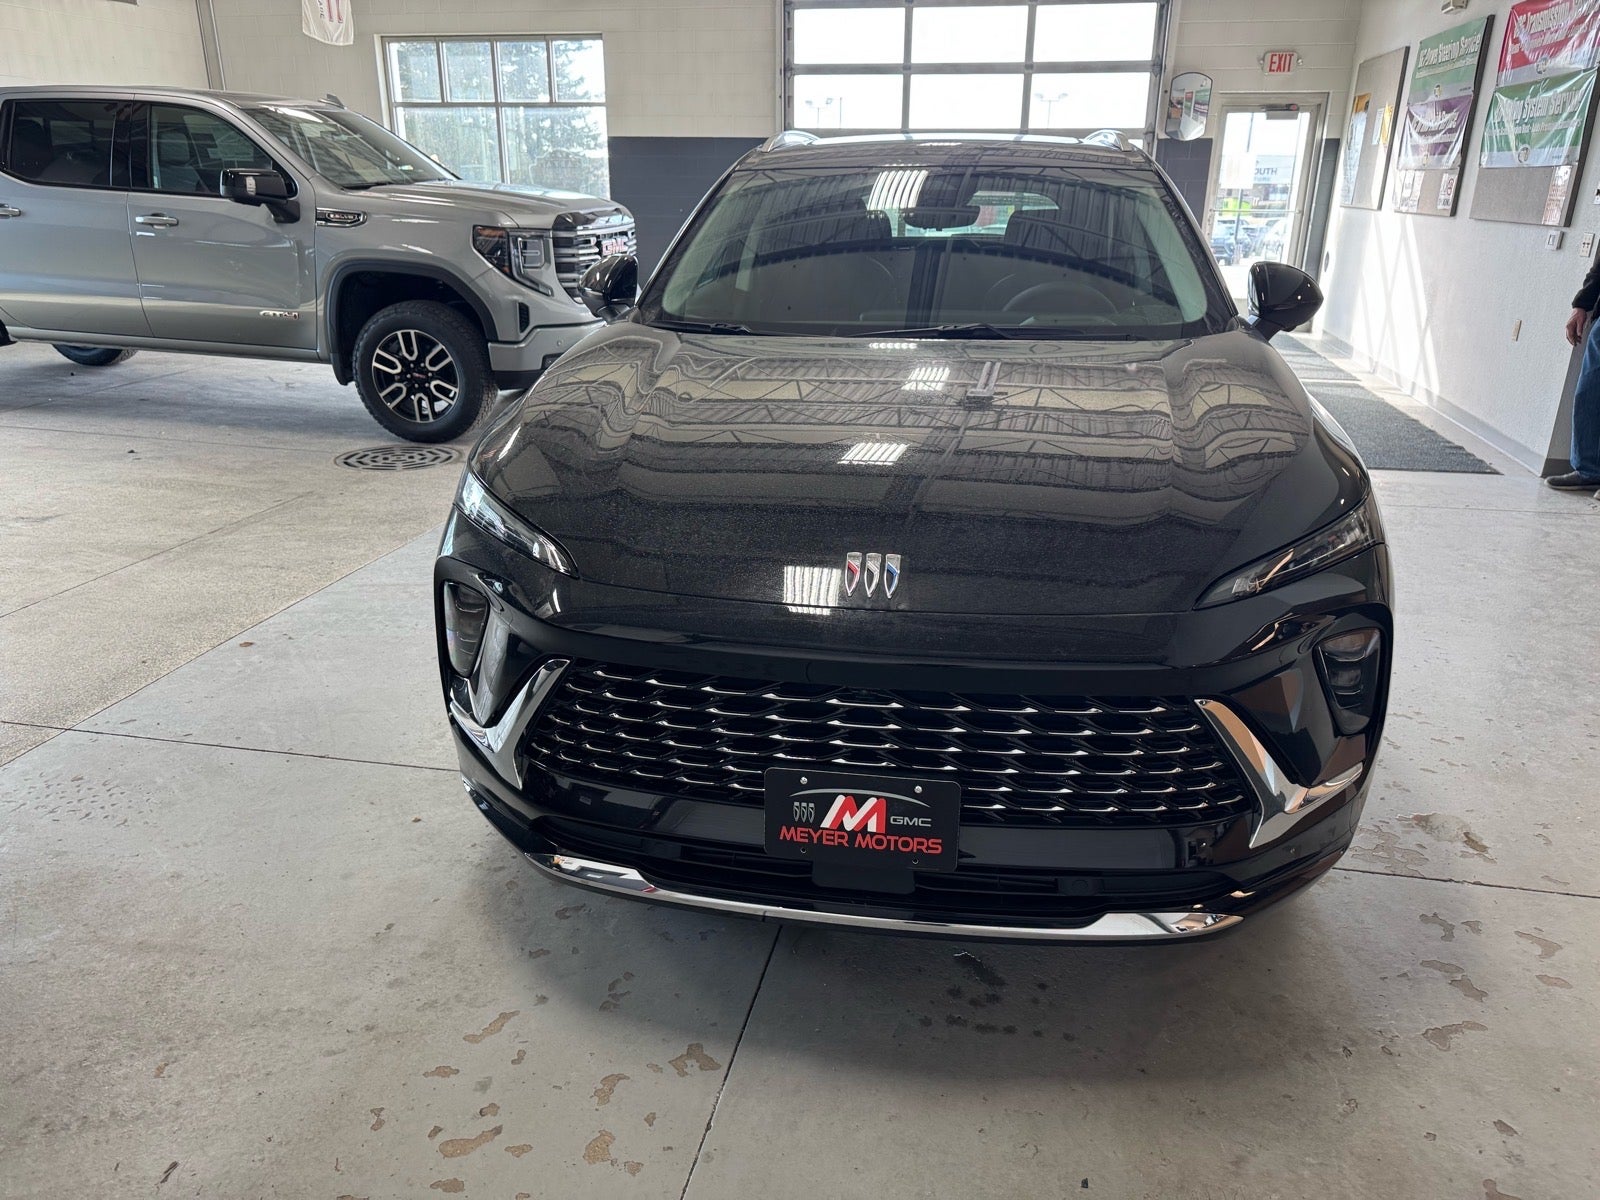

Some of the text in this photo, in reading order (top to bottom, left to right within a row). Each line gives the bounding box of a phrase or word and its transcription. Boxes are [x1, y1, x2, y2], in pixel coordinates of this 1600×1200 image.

[1269, 54, 1294, 72] EXIT
[602, 235, 629, 256] GMC
[890, 815, 932, 827] GMC
[779, 825, 942, 854] MEYER MOTORS
